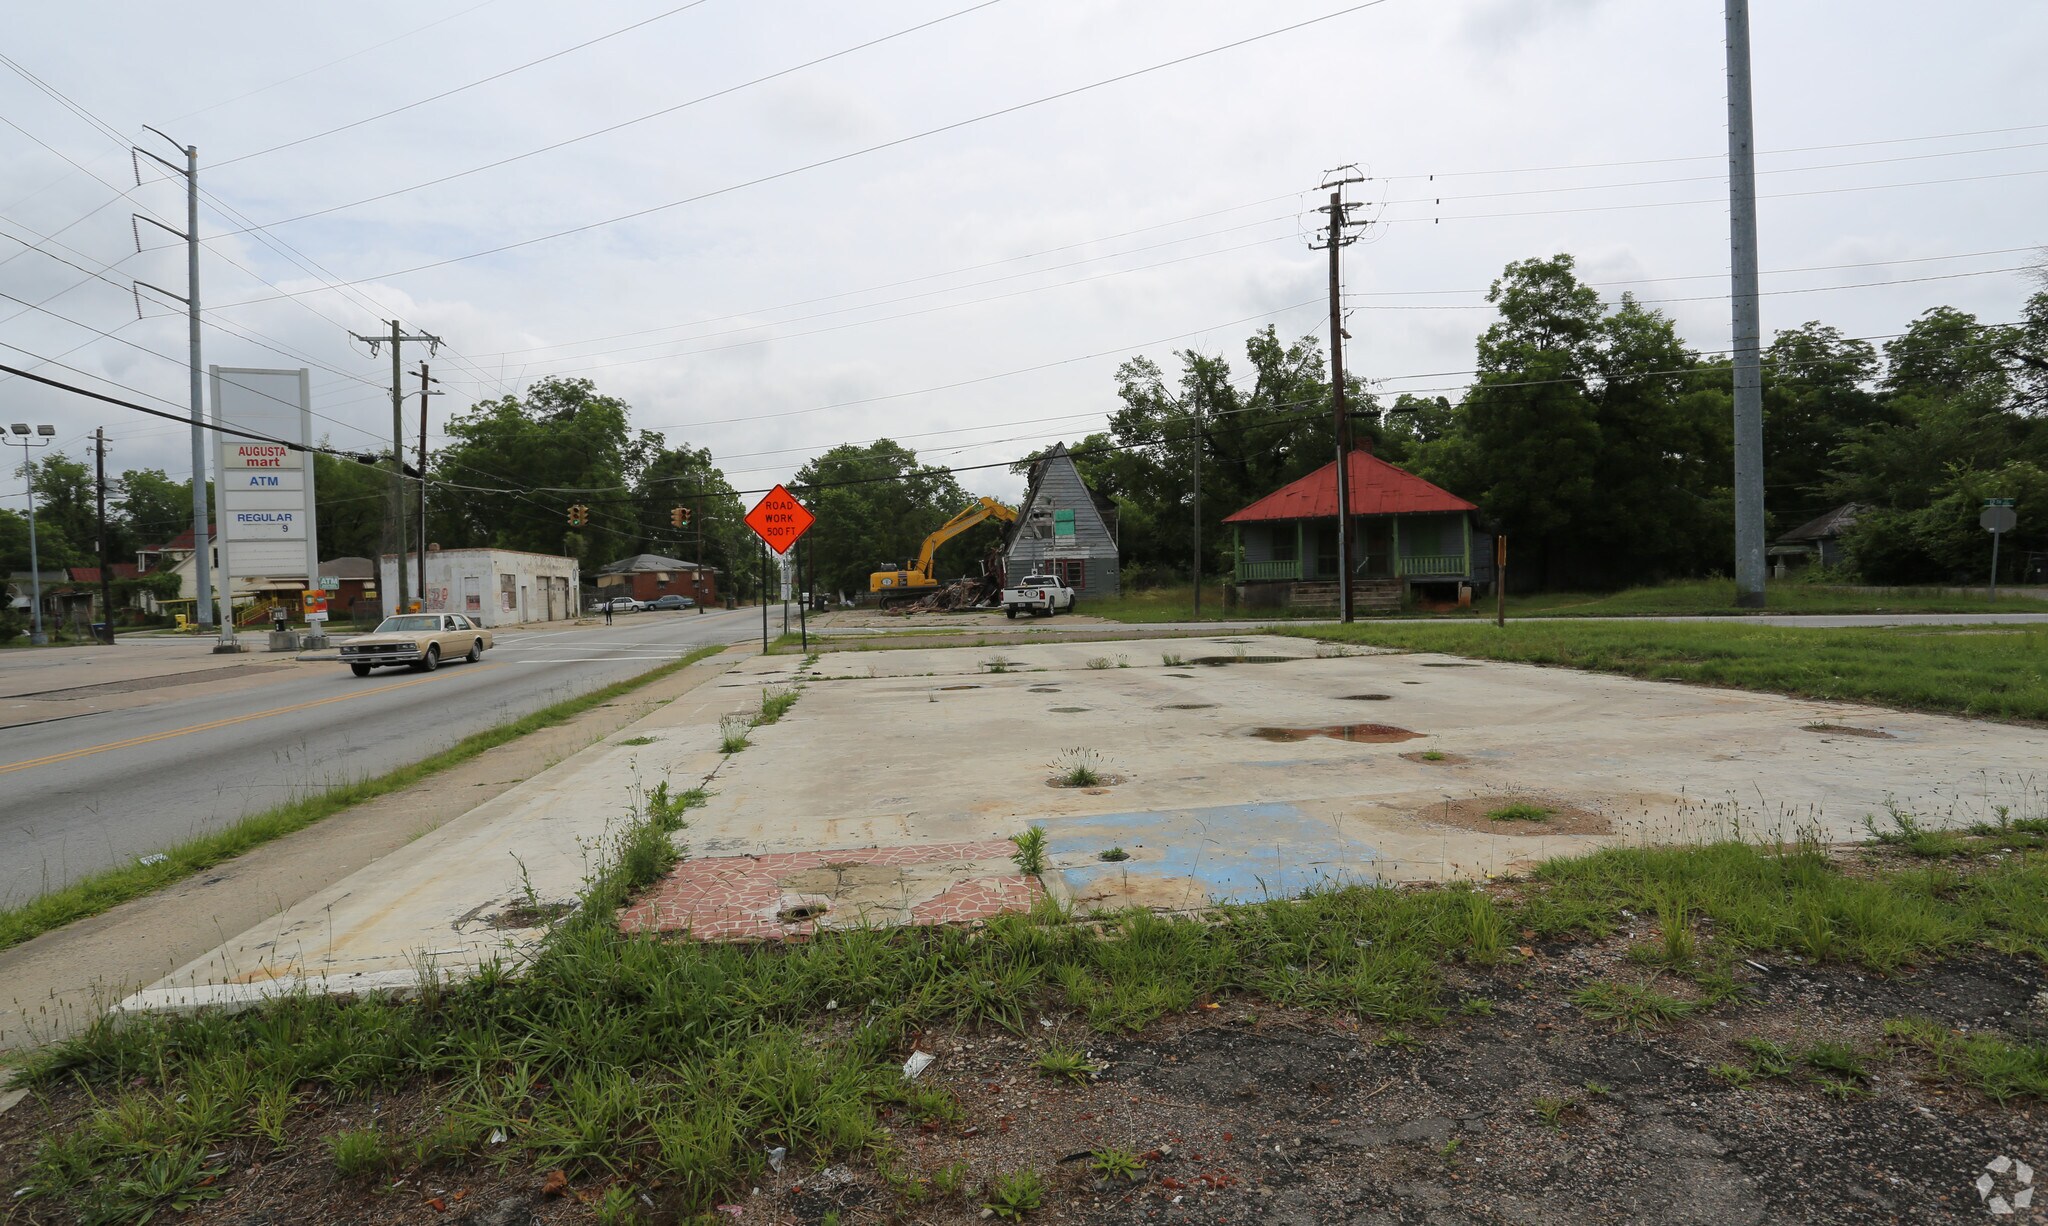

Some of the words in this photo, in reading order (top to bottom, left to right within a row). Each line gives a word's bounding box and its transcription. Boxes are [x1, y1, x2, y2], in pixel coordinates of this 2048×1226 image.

[238, 446, 287, 457] AUGUSTA
[246, 457, 281, 467] mart
[249, 476, 279, 486] ATM
[765, 501, 793, 510] ROAD
[237, 513, 293, 522] REGULAR
[765, 514, 793, 523] WORK
[282, 524, 289, 532] 9
[767, 527, 784, 536] 500
[785, 527, 796, 536] FT
[320, 577, 338, 585] ATM
